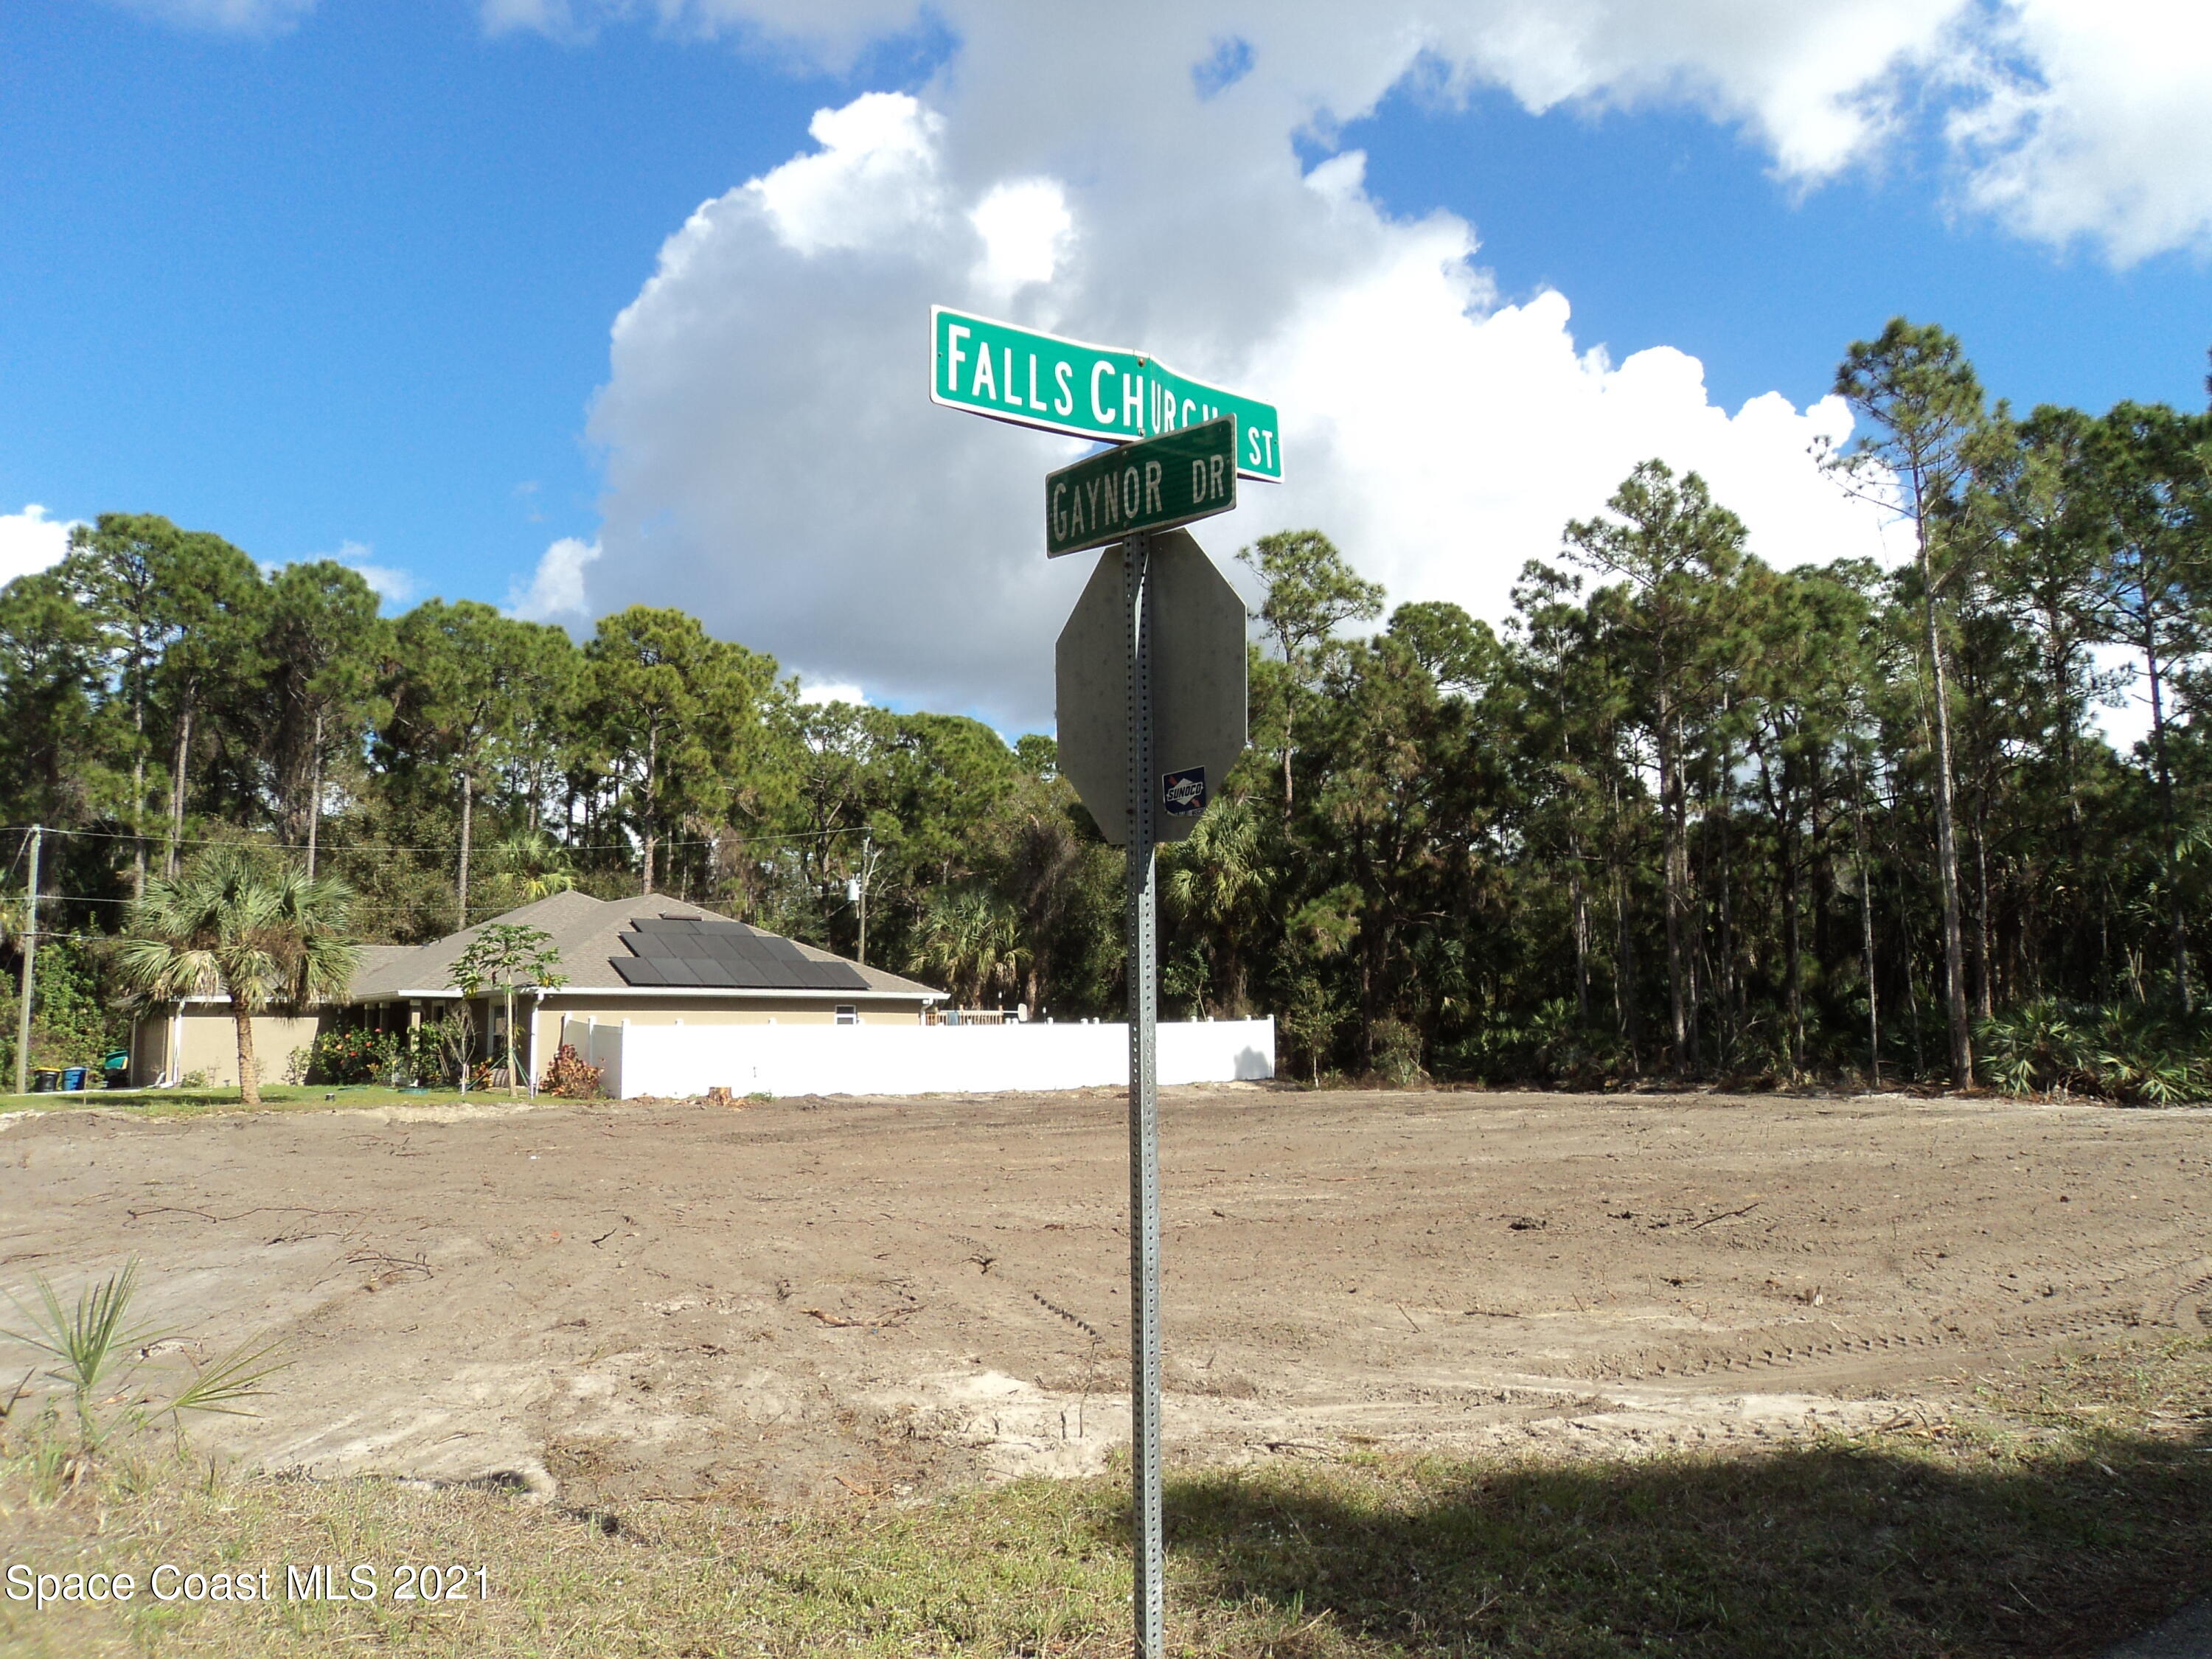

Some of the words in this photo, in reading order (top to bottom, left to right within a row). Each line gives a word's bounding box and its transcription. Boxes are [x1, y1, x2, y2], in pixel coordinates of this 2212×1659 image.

[947, 323, 1074, 417] FALLS
[1248, 426, 1273, 469] ST
[1052, 460, 1163, 542] GAYNOR
[1192, 454, 1225, 504] DR
[1167, 783, 1202, 801] SUNOCO
